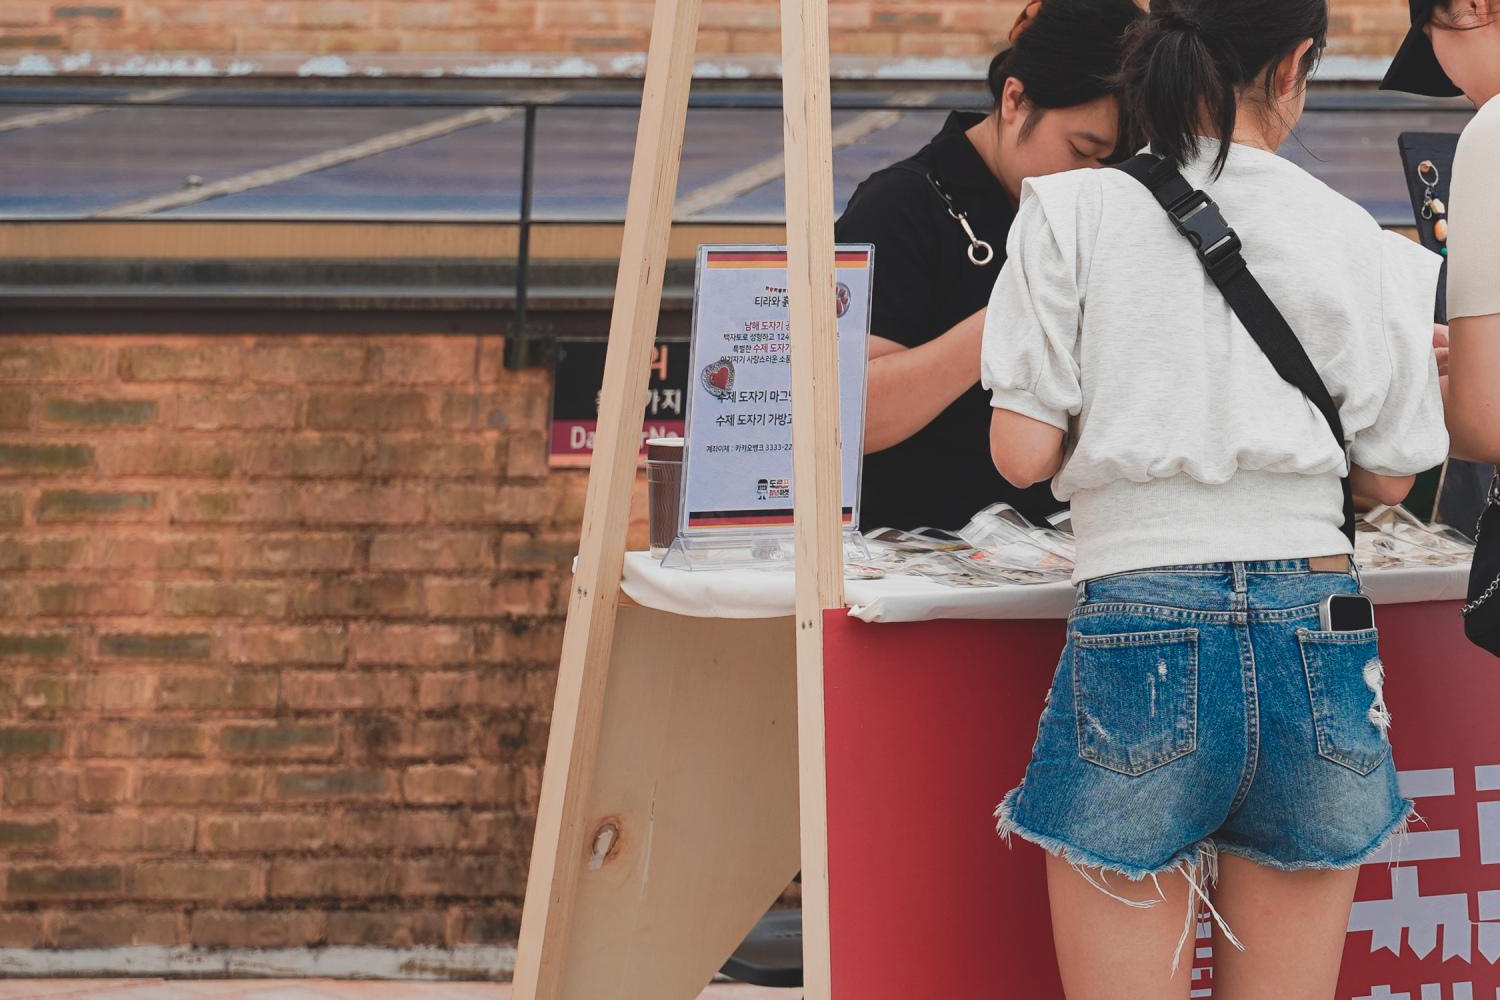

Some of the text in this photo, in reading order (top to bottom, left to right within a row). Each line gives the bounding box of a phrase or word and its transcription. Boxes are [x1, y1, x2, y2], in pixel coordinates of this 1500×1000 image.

[754, 295, 780, 308] 티라와
[744, 320, 760, 332] 남해
[761, 320, 784, 331] 도자기
[733, 344, 751, 354] 특별한
[753, 343, 768, 352] 수제
[720, 355, 746, 364] 아기자기
[746, 355, 778, 364] 사랑스러운
[717, 390, 792, 404] 수제 도자기 마그
[715, 413, 735, 427] 수제
[737, 413, 766, 426] 도자기
[735, 443, 764, 452] 카카오뱅크
